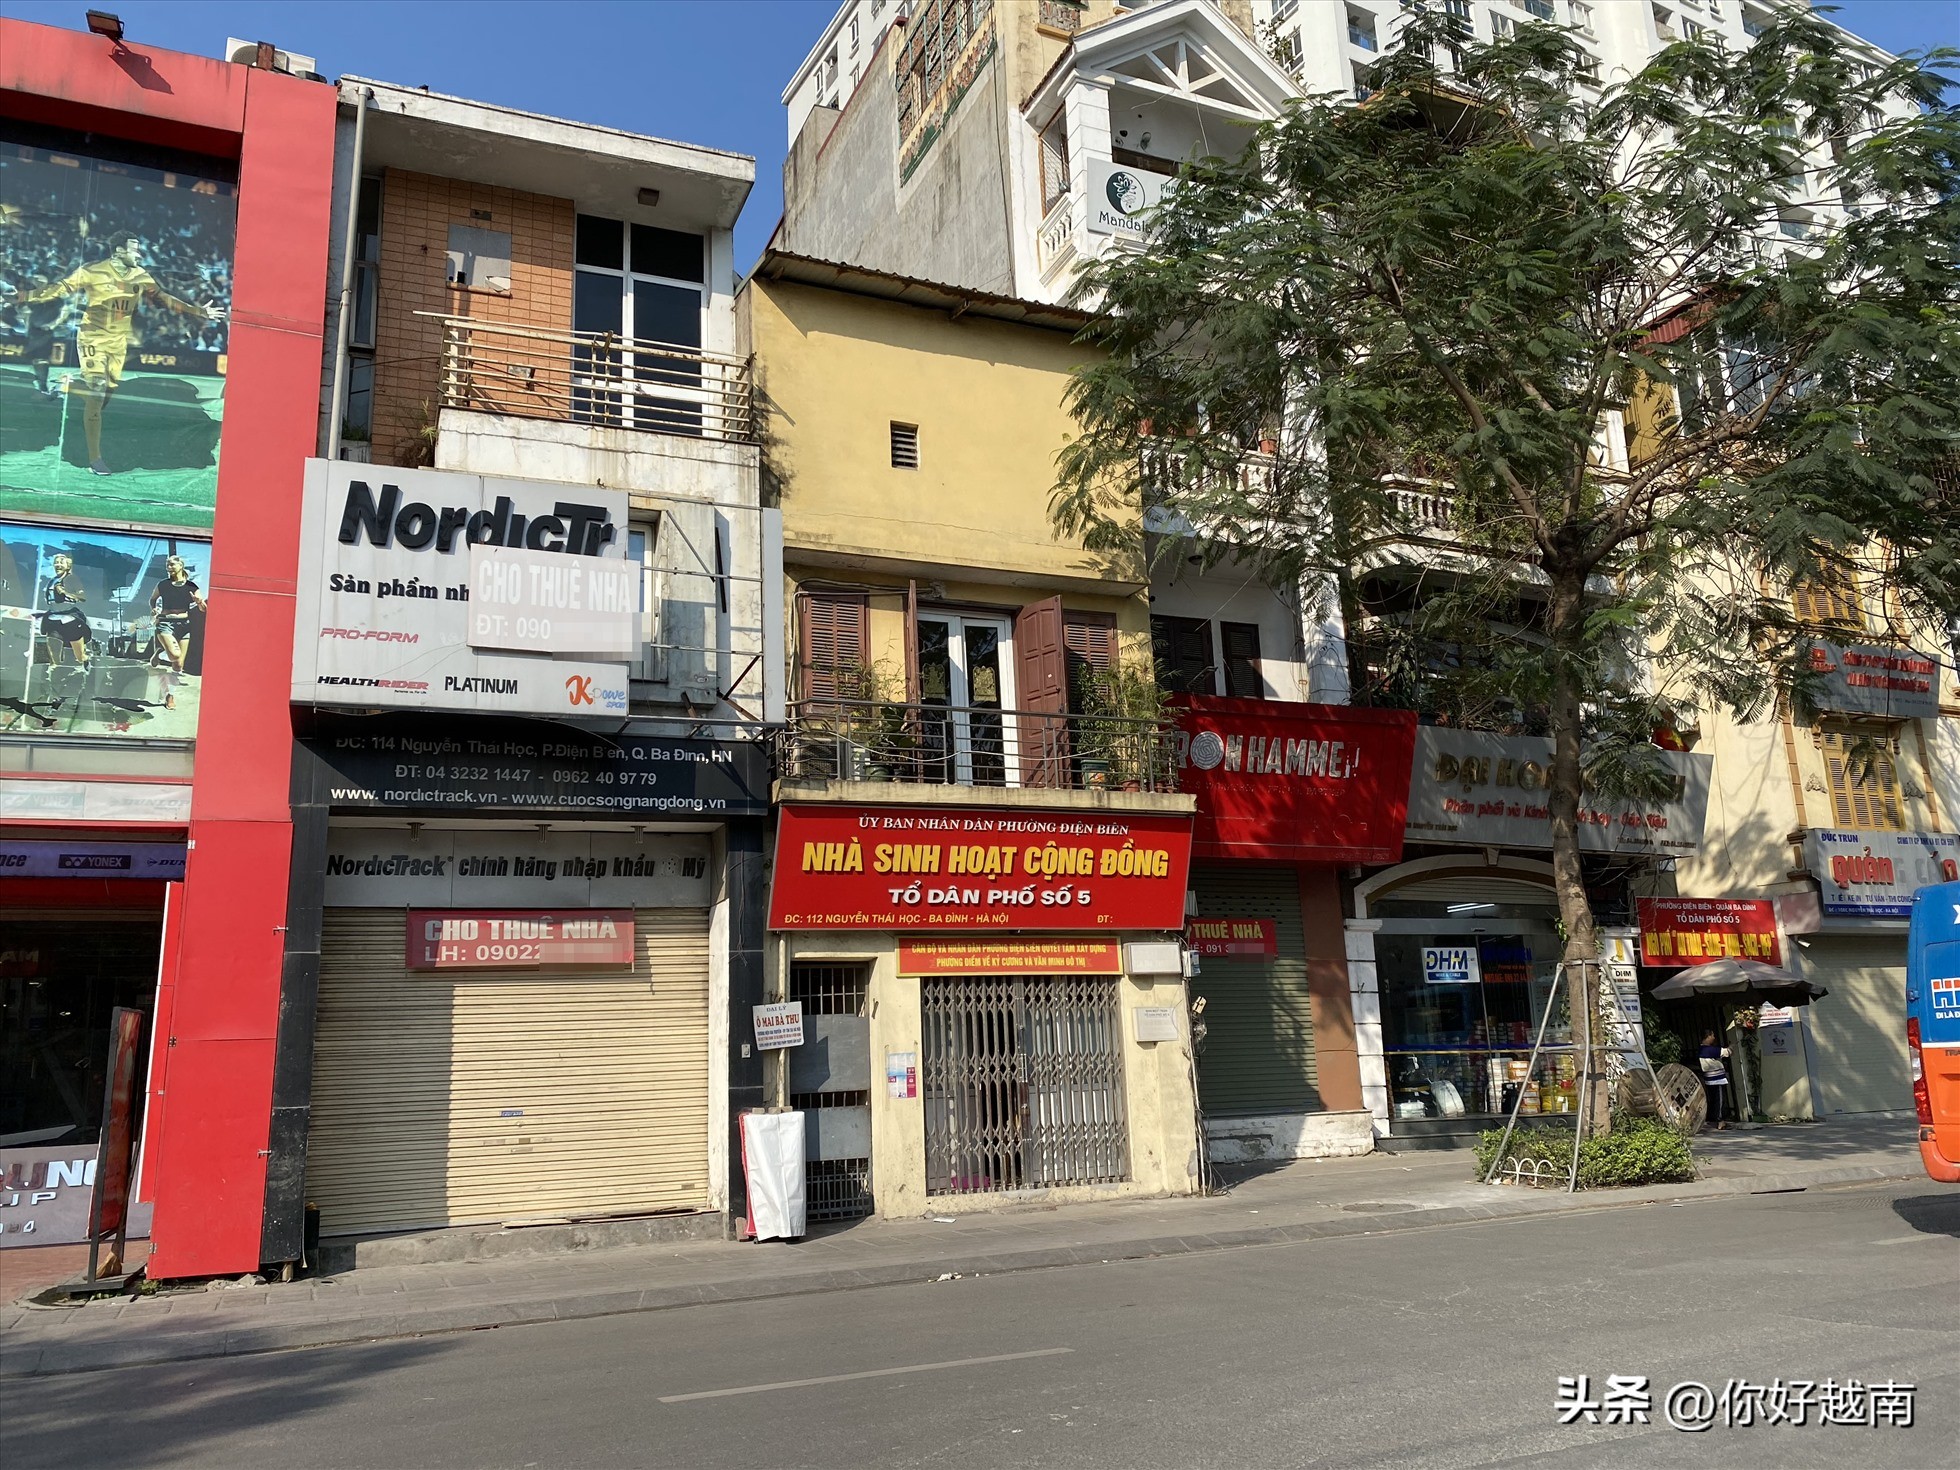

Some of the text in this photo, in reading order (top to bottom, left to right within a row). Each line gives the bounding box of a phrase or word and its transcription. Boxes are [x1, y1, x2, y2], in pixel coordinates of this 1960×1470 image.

[329, 573, 370, 594] Sản
[377, 577, 438, 601] phẩm
[478, 559, 631, 612] CHO THUÊ NHÀ
[320, 627, 419, 644] PRO-FORM
[475, 614, 509, 639] ĐT:
[317, 675, 518, 695] HEALTHRIDER PLATINUM
[372, 737, 395, 749] 114
[401, 738, 461, 755] Nguyễn
[504, 742, 538, 758] Học,
[632, 747, 647, 760] Q.
[651, 748, 671, 761] Ba
[711, 750, 732, 762] HN
[395, 765, 421, 778] ĐT:
[426, 766, 445, 778] 04
[450, 767, 488, 780] 3232
[494, 769, 531, 782] 1447
[552, 770, 589, 783] 0962
[596, 771, 614, 784] 40
[511, 793, 726, 811] www.cuocsongnangdong.vn
[858, 813, 1129, 836] ỦY BAN NHÂN DÂN PHƯỜNG ĐIỆN BIÊN
[1821, 831, 1837, 842] ĐỨC
[88, 857, 122, 867] YONEX
[458, 853, 508, 877] chính
[513, 855, 556, 880] hãng
[562, 855, 607, 881] nhập
[612, 853, 655, 877] khẩu
[682, 855, 706, 880] Mỹ
[802, 836, 1169, 880] NHÀ SINH HOẠT CỘNG ĐỒNG
[888, 880, 1091, 905] TỔ DÂN PHỐ SỐ 5
[785, 915, 803, 924] ĐC:
[806, 914, 823, 923] 112
[825, 911, 869, 924] NGUYỄN
[872, 912, 895, 923] THÁI
[899, 914, 921, 925] HỌC
[929, 914, 943, 923] BA
[945, 911, 968, 923] ĐÌNH
[976, 911, 990, 923] HÀ
[992, 912, 1009, 924] NỘI
[1676, 911, 1740, 923] TỔ DÂN PHỐ SỐ 5
[424, 915, 617, 941] CHO THUÊ NHÀ
[1193, 921, 1264, 938] THUÊ NHÀ
[424, 946, 466, 962] LH:
[1206, 944, 1221, 953] 091
[1426, 950, 1469, 970] DHM
[762, 1016, 775, 1027] MAI
[775, 1013, 785, 1026] BÀ
[785, 1014, 800, 1025] THU
